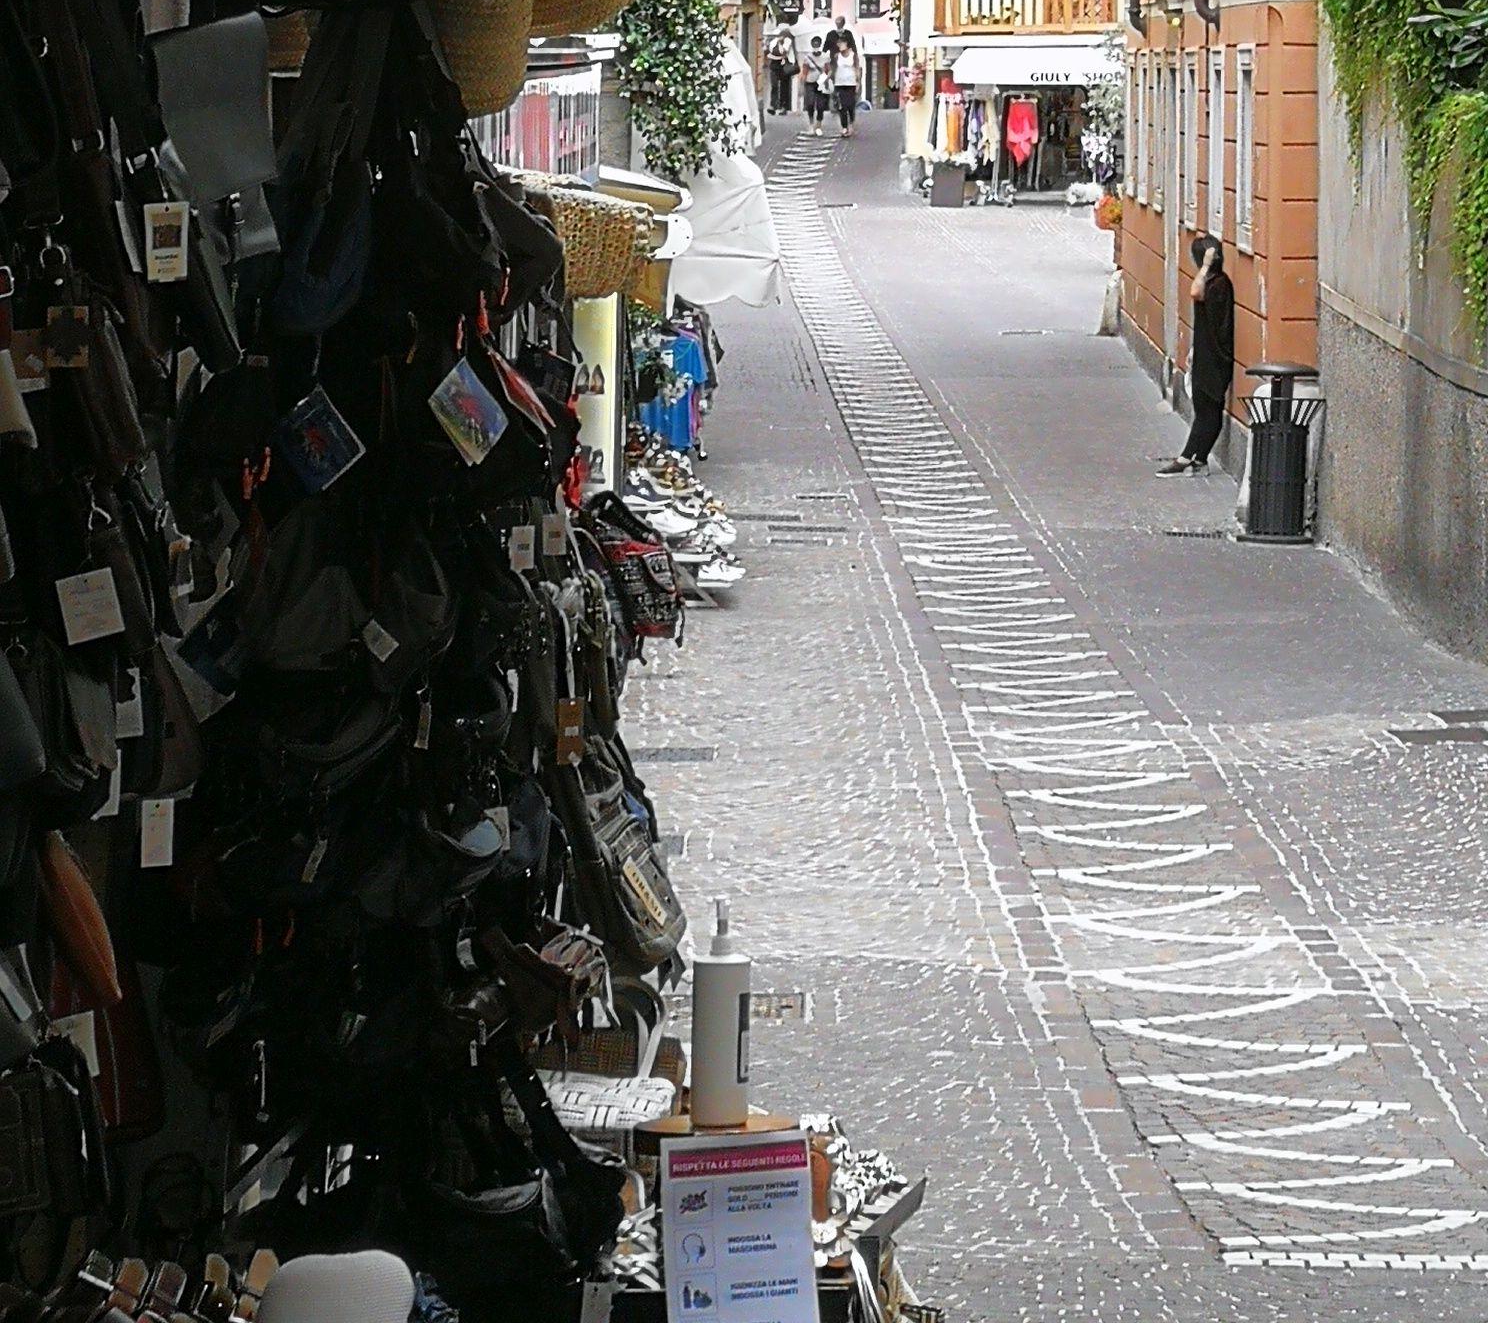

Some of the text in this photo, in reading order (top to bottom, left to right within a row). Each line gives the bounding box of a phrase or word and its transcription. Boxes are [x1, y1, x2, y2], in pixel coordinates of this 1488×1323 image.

[1030, 72, 1071, 82] GIULY
[672, 1160, 717, 1172] RISPETTA
[718, 1160, 729, 1169] LE
[731, 1157, 774, 1168] SEGUENTI
